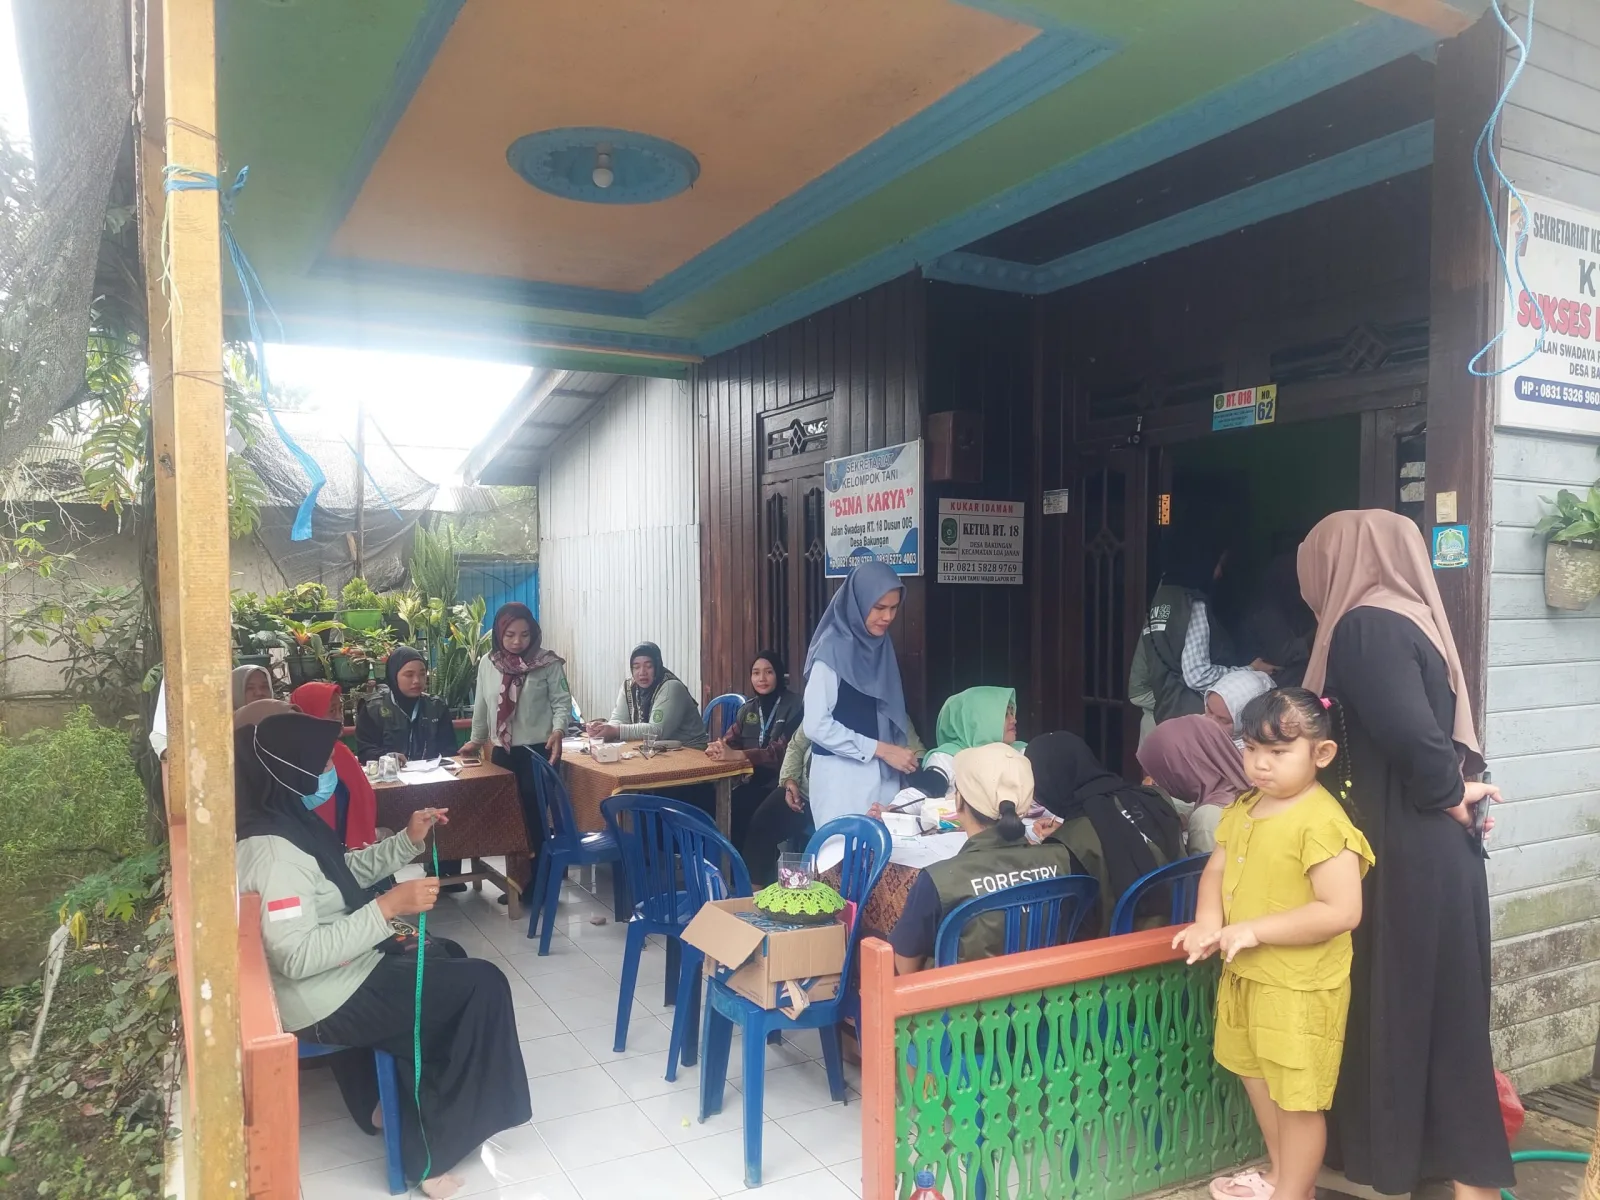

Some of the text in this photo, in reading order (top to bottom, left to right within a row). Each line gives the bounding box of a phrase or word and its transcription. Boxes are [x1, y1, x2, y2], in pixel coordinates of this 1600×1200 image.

[1533, 212, 1589, 251] SEKRETARIAT
[1517, 289, 1591, 340] SUKSES
[1559, 343, 1596, 362] SWADAYA
[1569, 363, 1589, 378] DESA
[1238, 390, 1252, 405] 018
[1540, 383, 1561, 400] 0831
[1563, 386, 1583, 403] 5326
[1257, 401, 1273, 421] 62
[846, 453, 894, 473] SEKRETARIAT
[842, 469, 898, 489] KELOMPOK TANI
[950, 502, 1013, 514] KUKAR IDAMAN
[963, 523, 990, 536] KETUA
[1009, 525, 1019, 537] 18
[957, 562, 975, 572] 0821
[978, 563, 997, 572] 5828
[998, 563, 1017, 573] 9769
[970, 865, 1058, 896] FORESTRY
